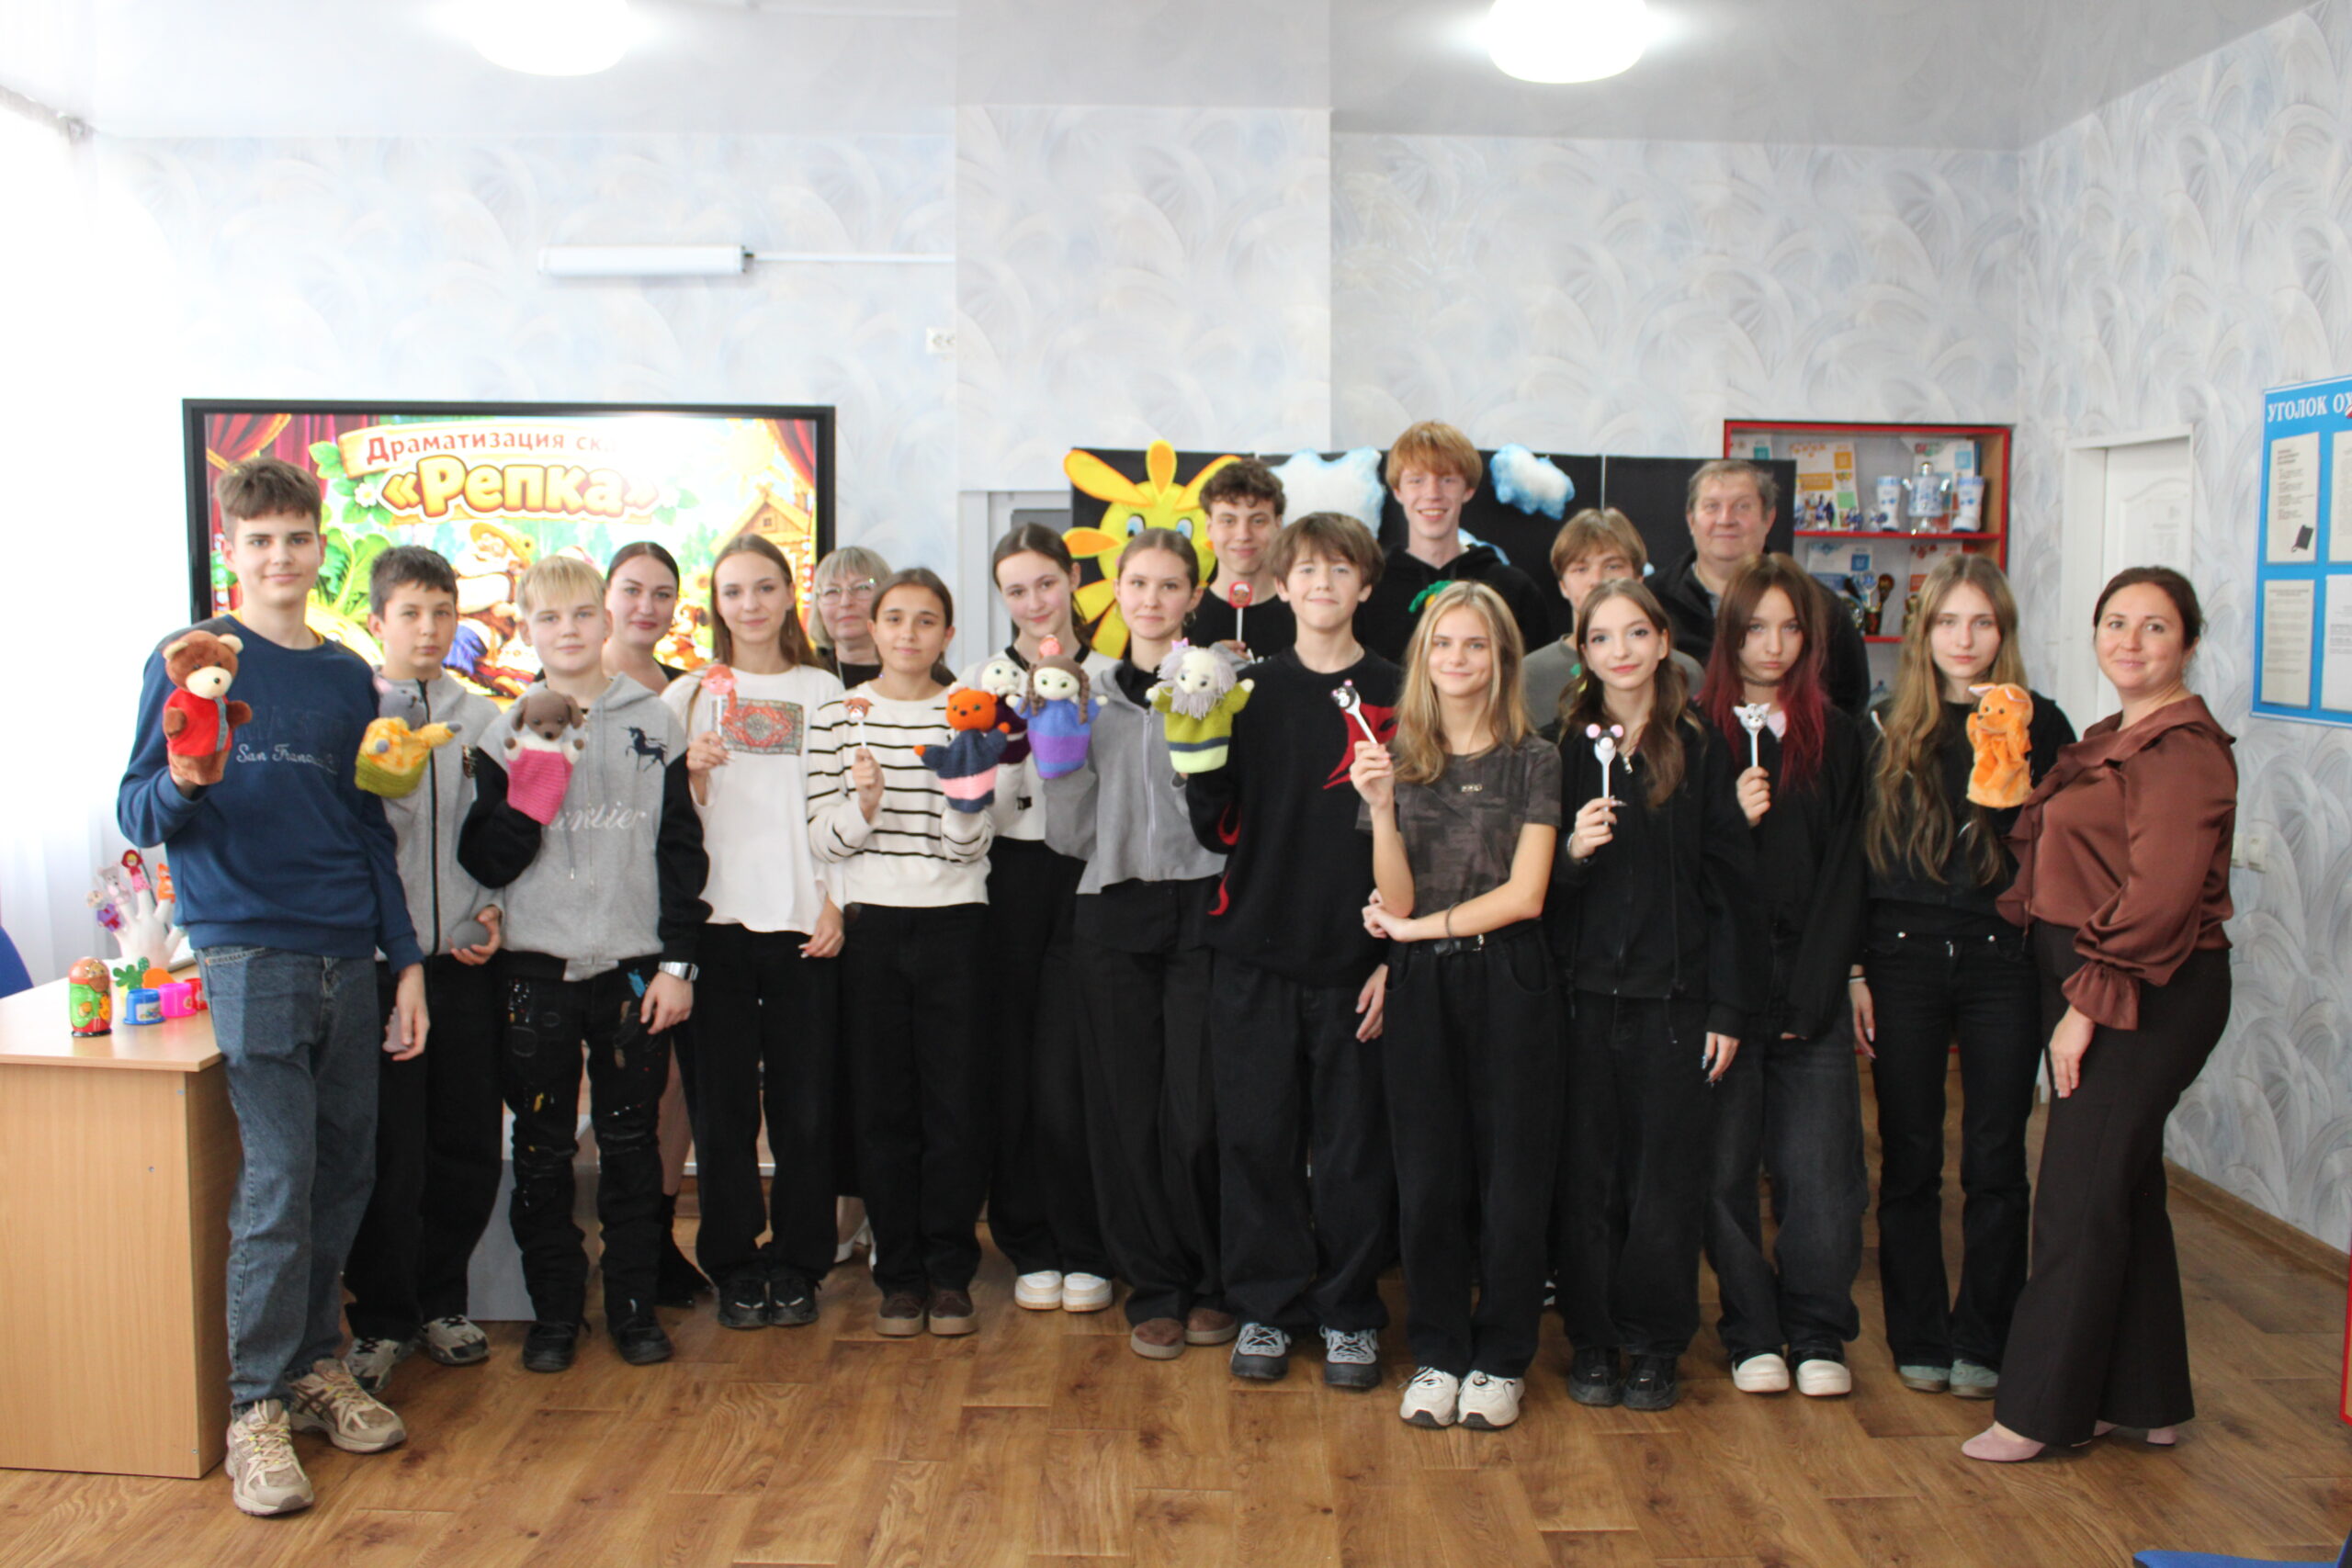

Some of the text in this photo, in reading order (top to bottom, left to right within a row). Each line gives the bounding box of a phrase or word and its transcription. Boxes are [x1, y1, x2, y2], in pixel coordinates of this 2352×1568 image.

[2267, 395, 2328, 423] УГОЛОК
[367, 432, 565, 466] Драматизация
[235, 743, 267, 763] San
